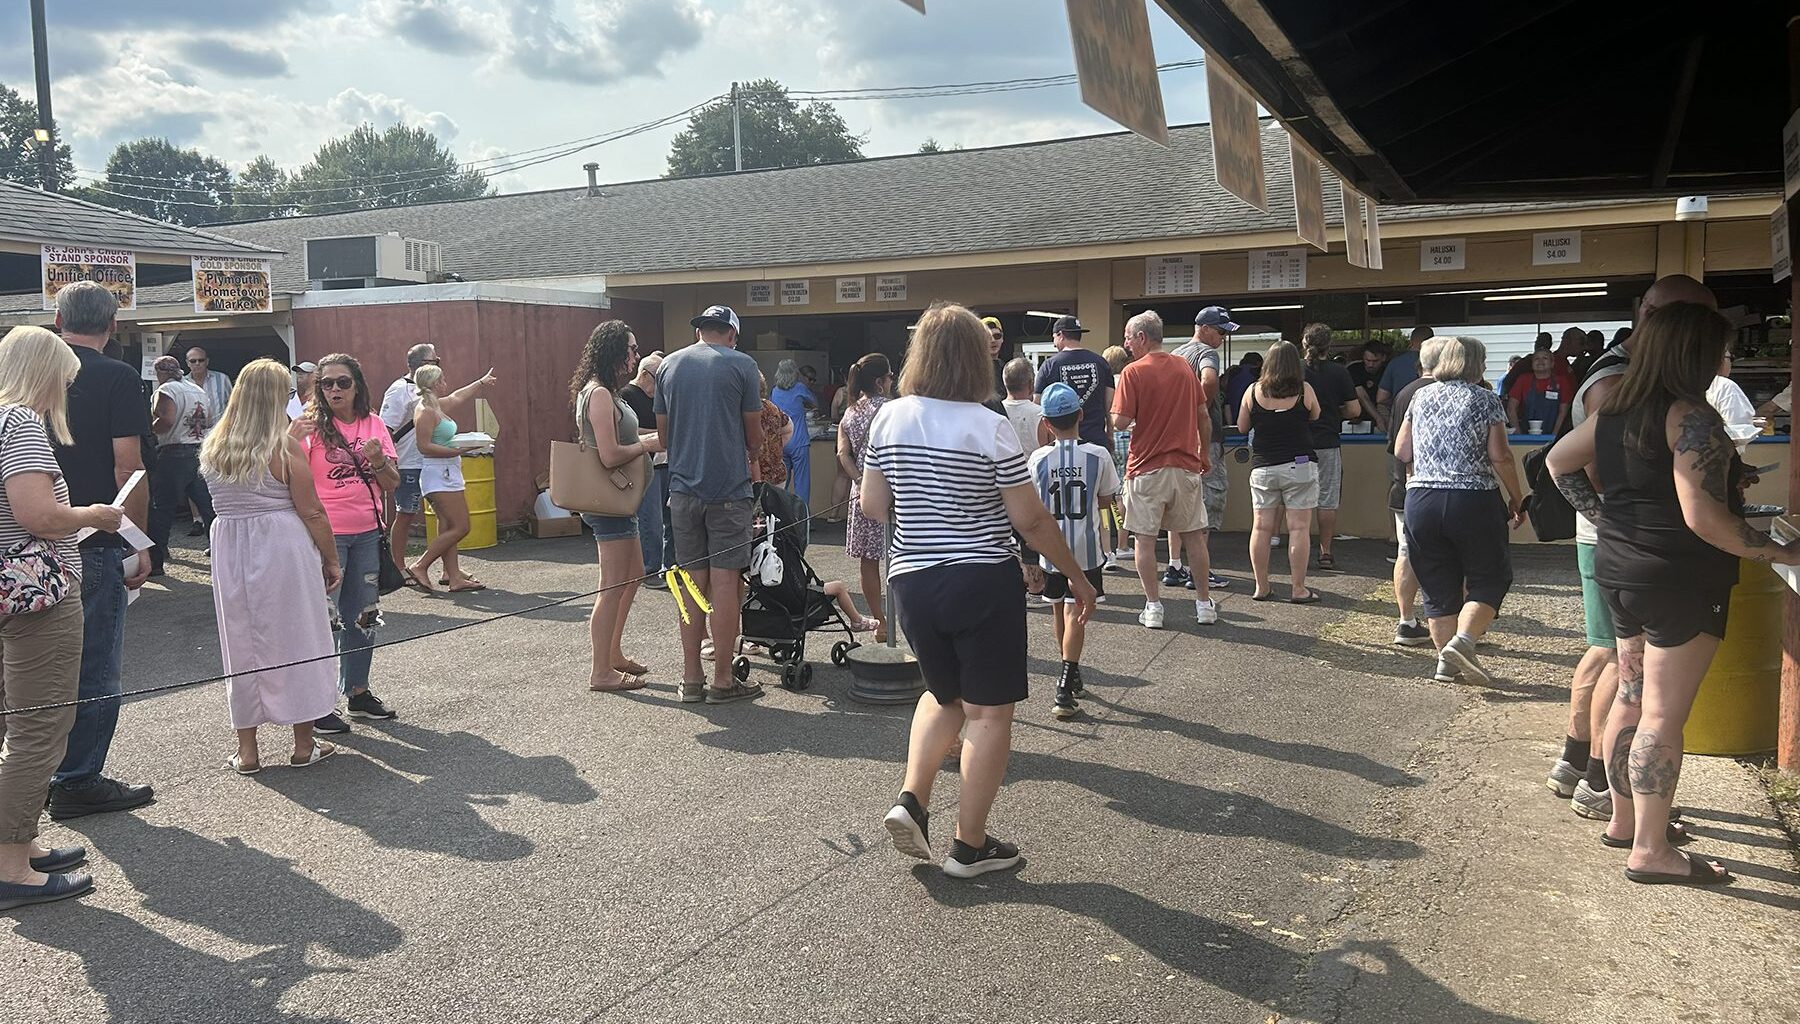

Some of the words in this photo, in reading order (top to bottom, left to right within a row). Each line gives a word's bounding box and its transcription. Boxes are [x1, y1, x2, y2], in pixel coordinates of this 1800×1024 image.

[1543, 238, 1570, 248] HALUSKI
[44, 245, 59, 253] St.
[62, 246, 95, 254] John's
[97, 248, 133, 256] Church
[1430, 245, 1455, 254] HALUSKI
[1547, 250, 1566, 259] $4.00
[49, 253, 81, 262] STAND
[84, 254, 129, 264] SPONSOR
[1433, 256, 1452, 265] $4.00
[200, 261, 222, 270] GOLD
[224, 262, 262, 271] SPONSOR
[47, 268, 91, 282] Unified
[206, 273, 260, 286] Plymouth
[203, 286, 264, 297] Hometown
[215, 299, 255, 309] Market
[1051, 466, 1082, 478] MESSI
[1049, 480, 1087, 520] 10
